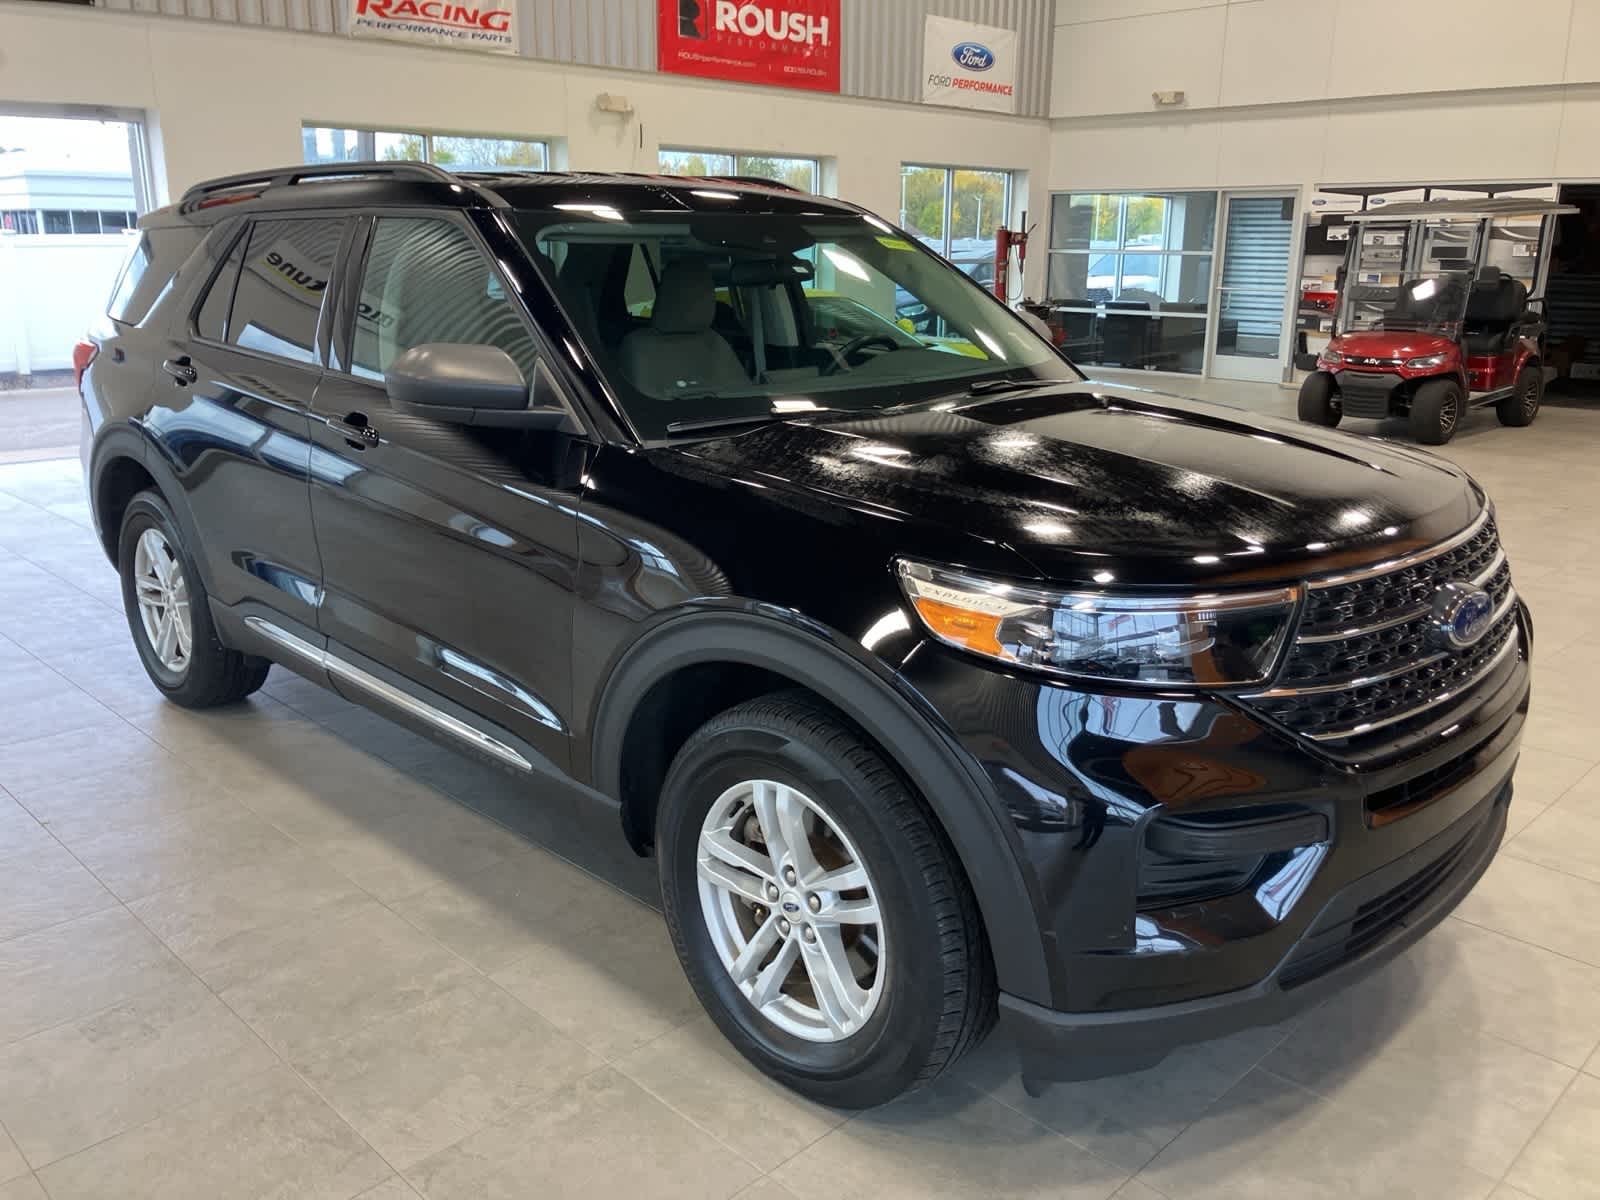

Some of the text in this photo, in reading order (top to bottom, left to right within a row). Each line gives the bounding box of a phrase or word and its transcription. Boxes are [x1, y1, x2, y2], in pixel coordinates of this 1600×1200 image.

[356, 0, 512, 32] RACING
[715, 0, 830, 46] ROUSH
[356, 18, 512, 43] PERFORMANCE PARTS
[960, 46, 987, 67] Ford
[928, 74, 1013, 96] FORD PERFORMANCE
